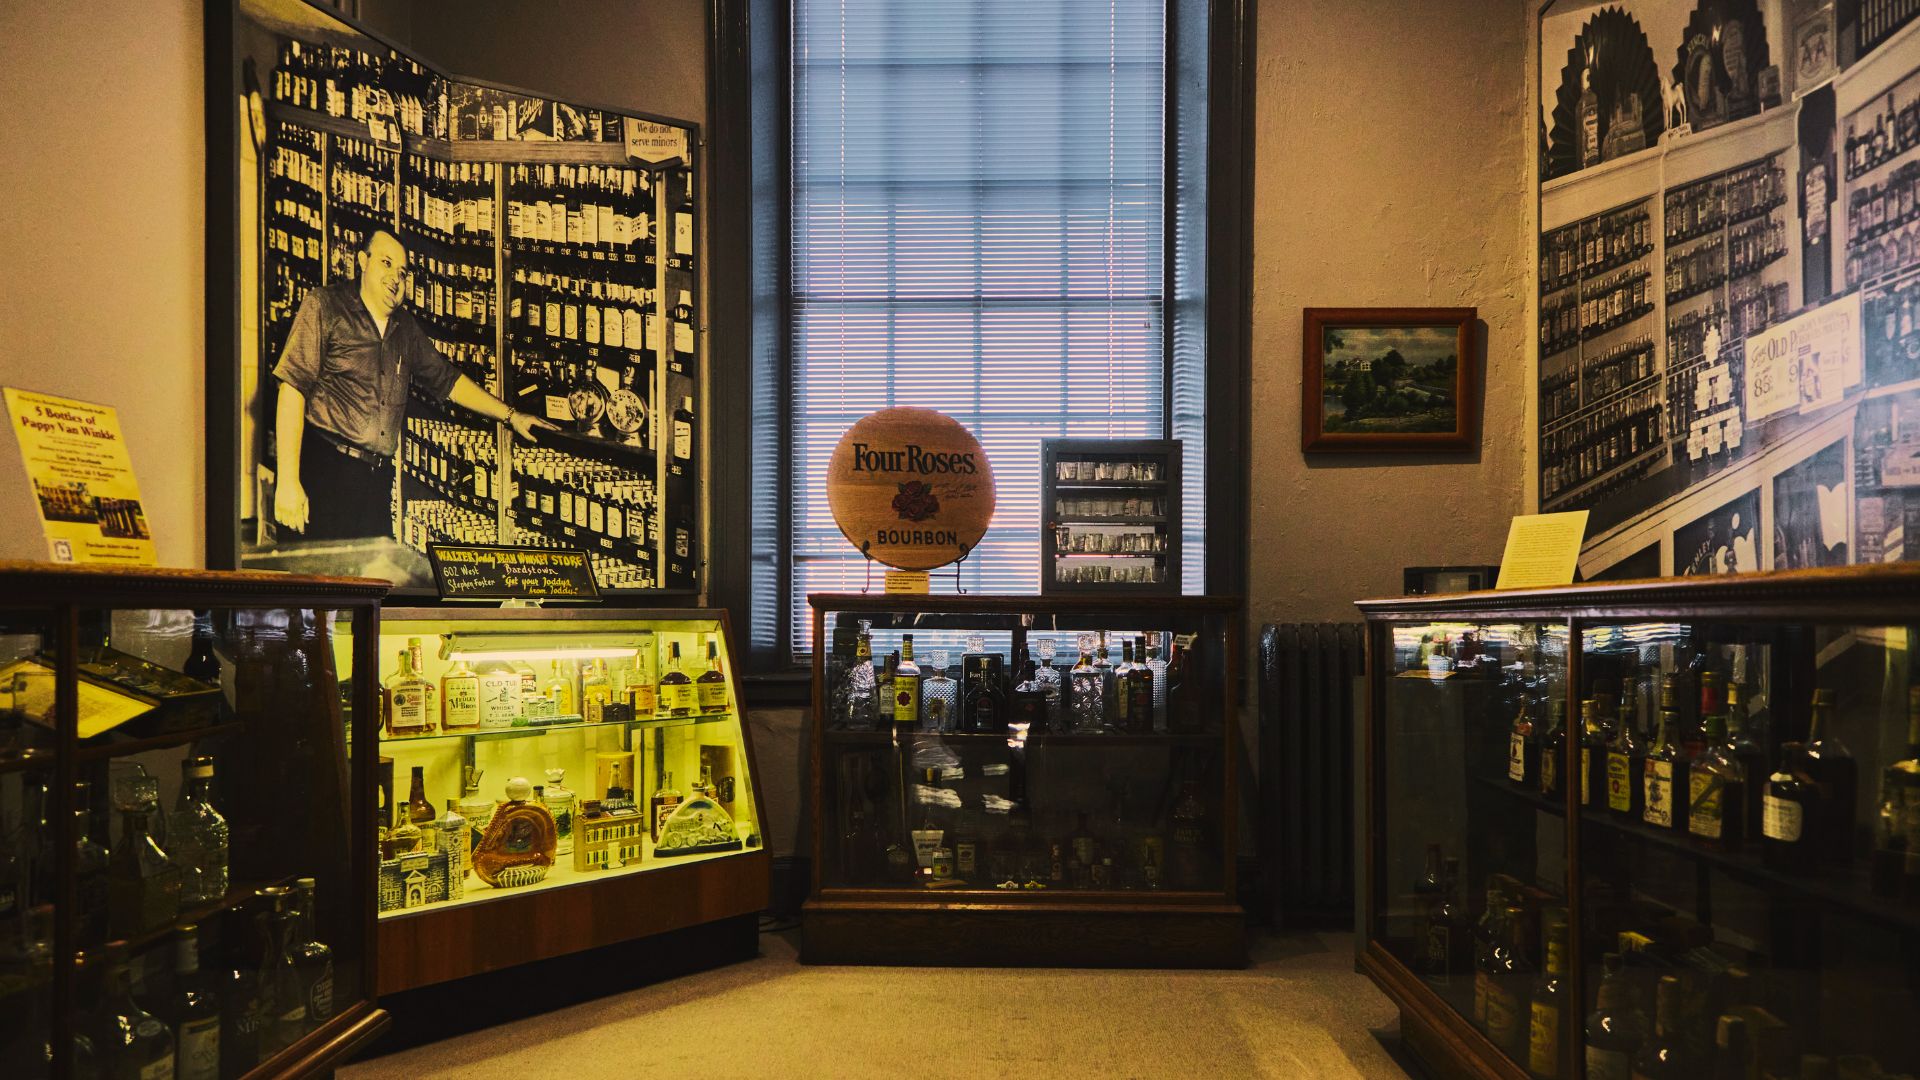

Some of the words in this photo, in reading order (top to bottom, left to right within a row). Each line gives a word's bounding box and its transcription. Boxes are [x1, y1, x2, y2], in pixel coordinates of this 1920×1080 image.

[637, 122, 648, 134] We
[649, 123, 659, 134] do
[659, 124, 672, 134] not
[631, 138, 650, 147] serve
[651, 135, 678, 147] minors
[35, 405, 43, 417] 5
[44, 407, 83, 424] Bottles
[85, 415, 97, 426] of
[21, 415, 55, 434] Pappy
[57, 421, 80, 436] Van
[80, 426, 116, 440] Winkle
[852, 443, 905, 473] Four
[905, 444, 976, 476] Roses
[877, 529, 957, 546] BOURBON
[435, 550, 475, 563] WALTER
[496, 552, 518, 565] BEAM
[551, 554, 584, 569] STORE
[443, 566, 460, 578] 602
[460, 564, 480, 576] West
[504, 563, 559, 577] Bardstown
[447, 578, 475, 593] Stephen
[474, 577, 496, 589] Foster
[521, 578, 539, 591] your
